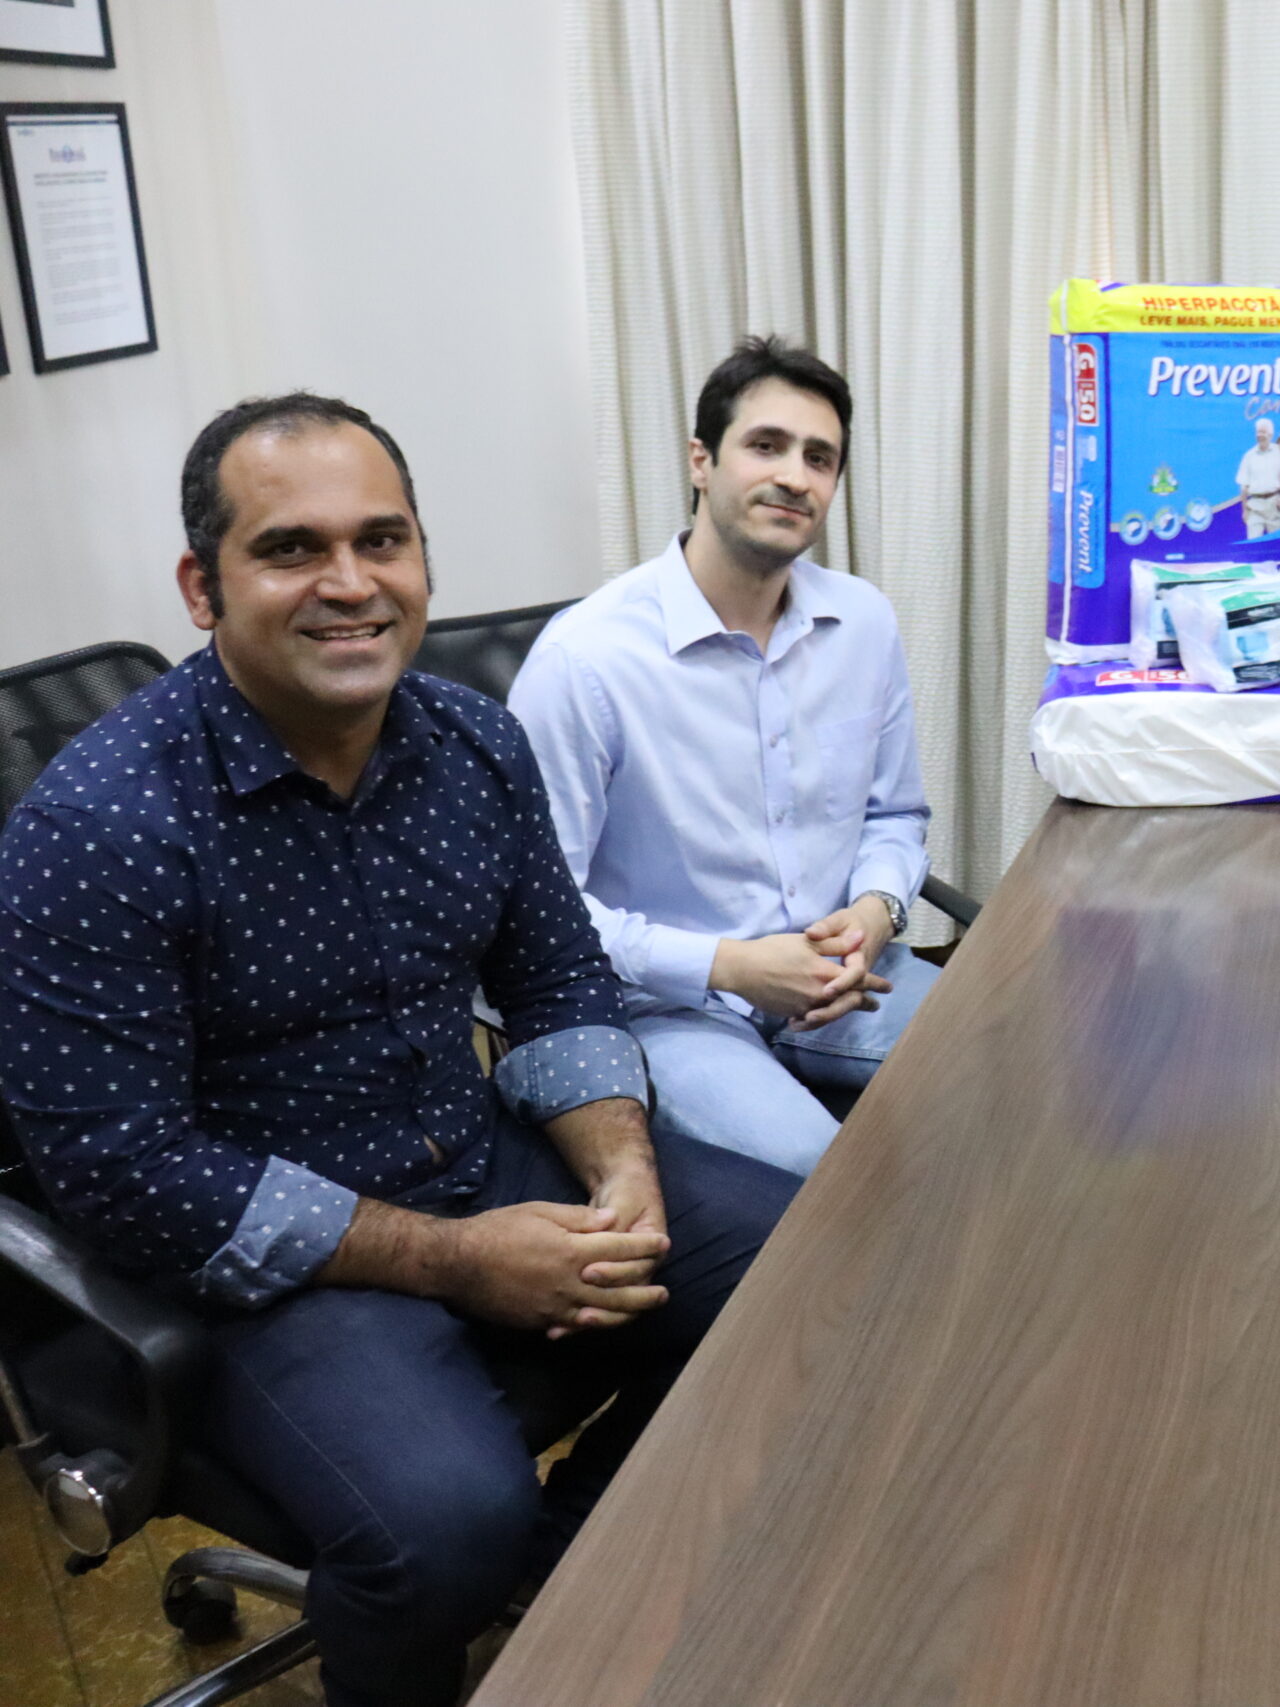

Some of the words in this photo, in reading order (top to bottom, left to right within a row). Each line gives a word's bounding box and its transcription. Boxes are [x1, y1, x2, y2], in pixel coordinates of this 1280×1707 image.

[1139, 315, 1172, 327] LEVE
[1214, 316, 1255, 328] PAGUE
[1077, 490, 1094, 573] Prevent
